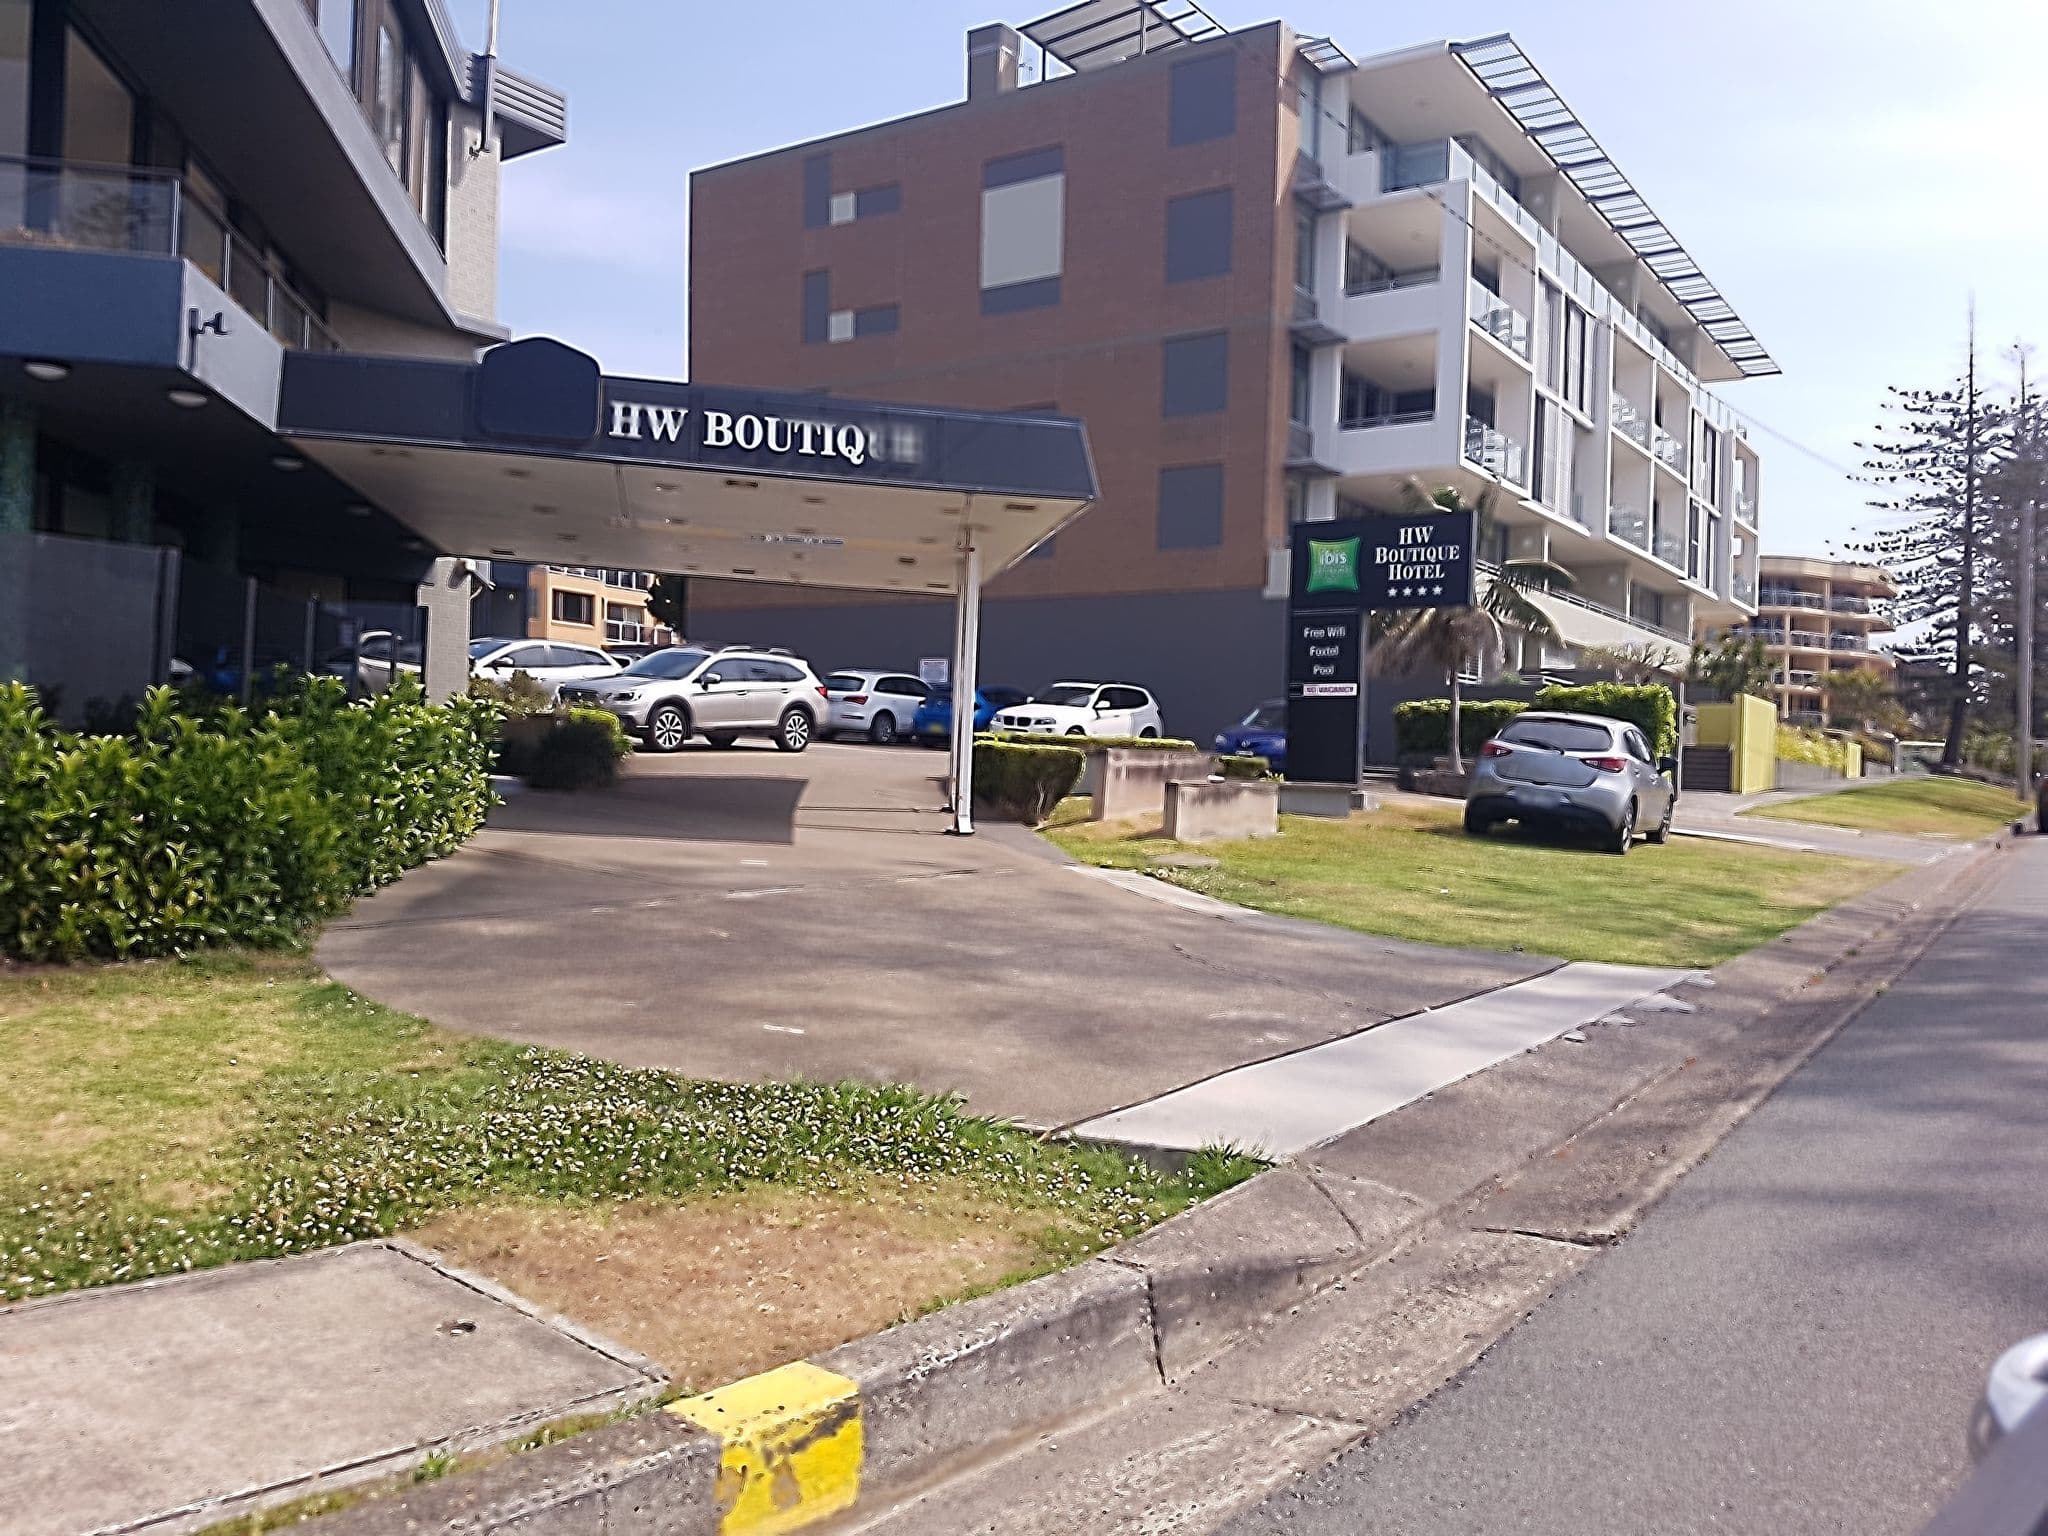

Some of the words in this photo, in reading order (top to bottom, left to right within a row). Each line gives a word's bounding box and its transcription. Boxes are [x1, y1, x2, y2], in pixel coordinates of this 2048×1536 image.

[608, 400, 688, 442] HW
[1399, 526, 1434, 545] HW
[1375, 545, 1460, 564] BOUTIQUE
[1388, 564, 1445, 580] HOTEL
[1303, 627, 1325, 638] Free
